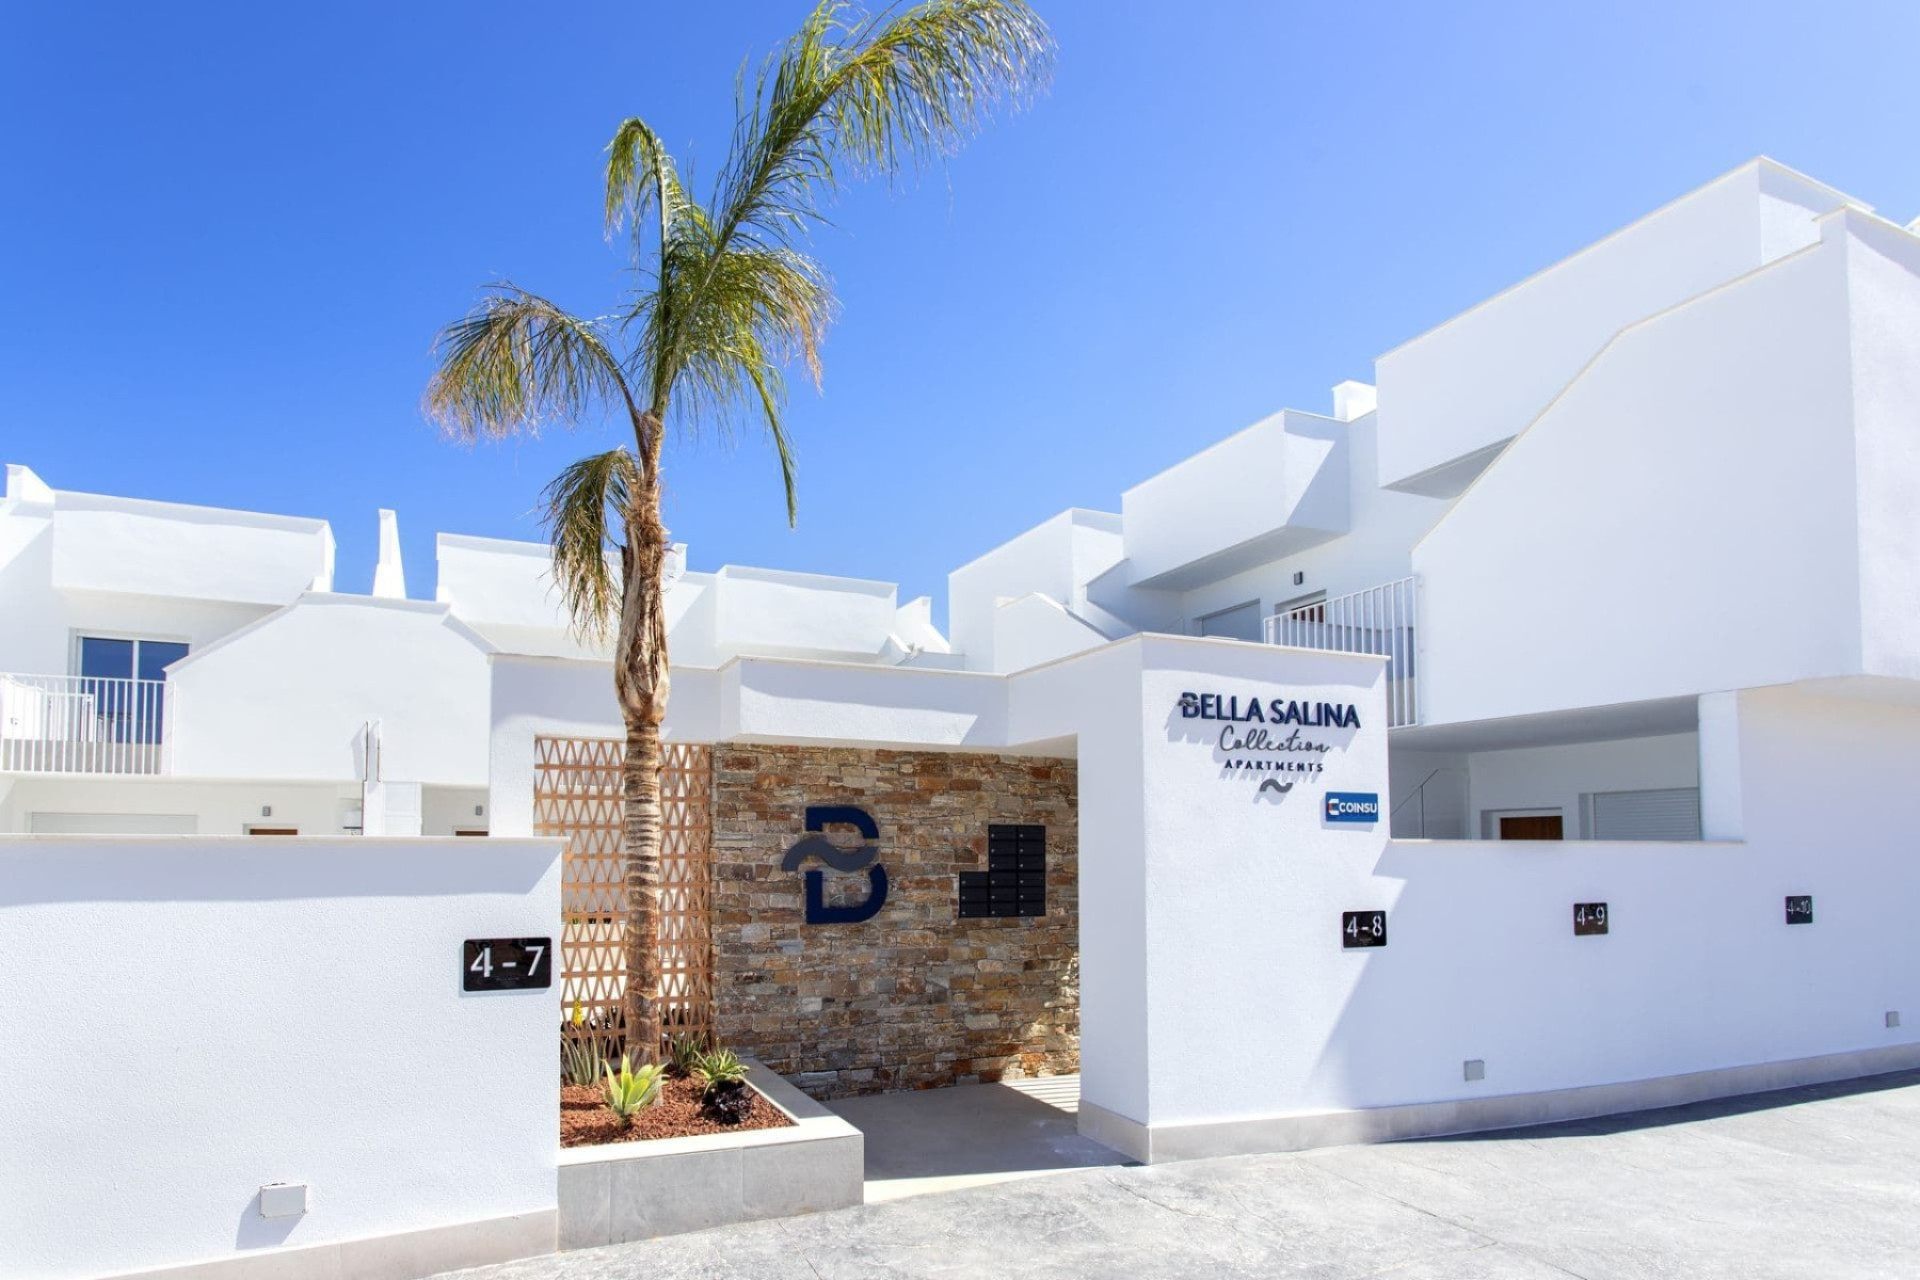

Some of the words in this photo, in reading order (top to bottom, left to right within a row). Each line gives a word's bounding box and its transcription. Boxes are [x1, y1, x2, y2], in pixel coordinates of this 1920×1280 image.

[1179, 692, 1265, 723] BELLA
[1270, 699, 1361, 729] SALINA
[1219, 725, 1330, 753] Collection
[1224, 759, 1324, 773] APARTMENTS
[1339, 802, 1378, 814] COINSU
